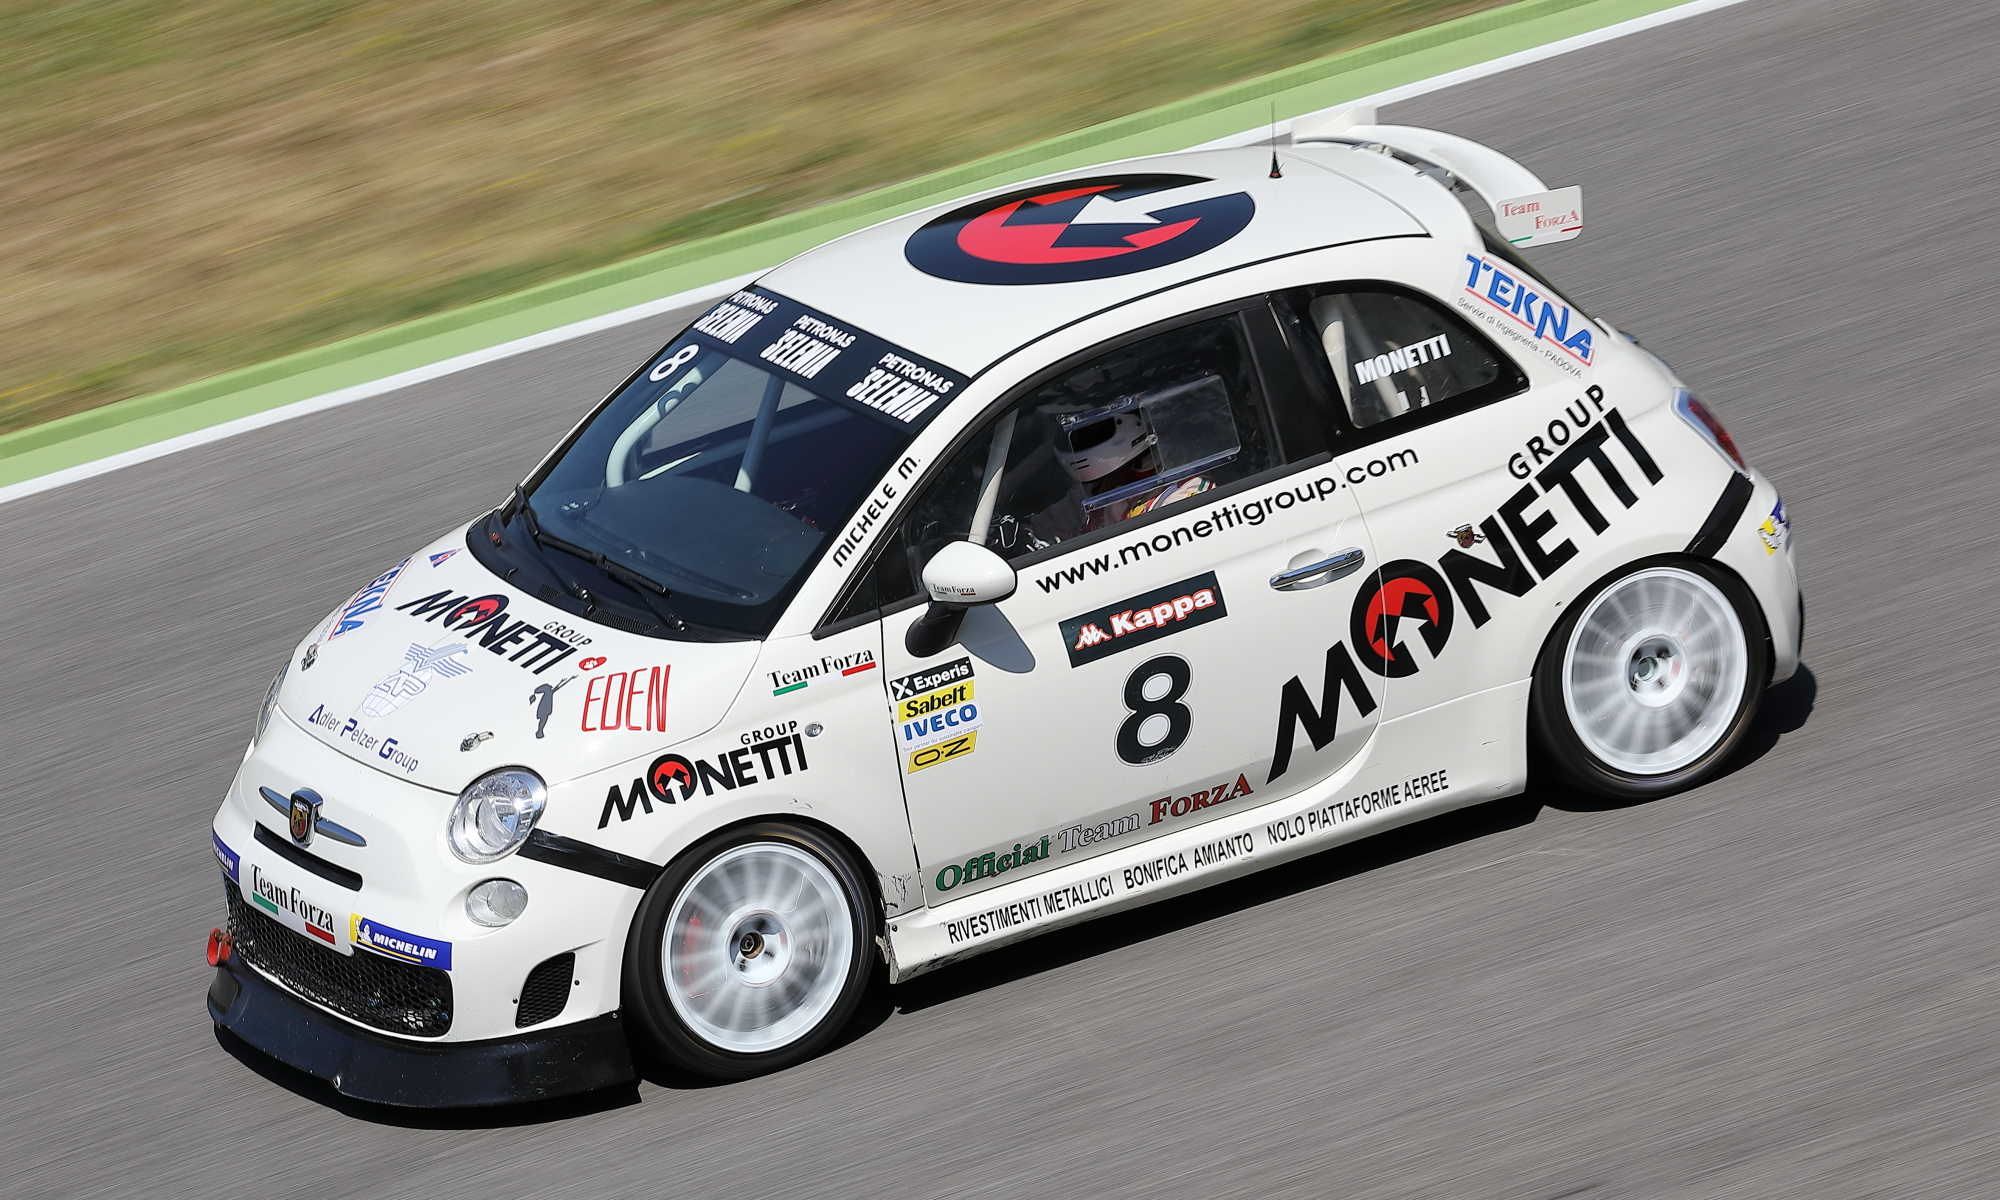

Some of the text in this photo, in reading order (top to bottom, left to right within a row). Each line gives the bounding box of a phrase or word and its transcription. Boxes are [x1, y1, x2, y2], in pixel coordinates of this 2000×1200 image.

[1501, 201, 1540, 218] Team
[728, 290, 780, 315] PETRONAS
[1466, 254, 1592, 359] TEKNA
[759, 328, 842, 380] SELENIA
[793, 314, 857, 348] PETRONAS
[1457, 297, 1486, 320] Servizi
[1485, 315, 1496, 326] di
[1495, 319, 1539, 352] Ingegneria
[1543, 350, 1583, 380] PADOVA
[649, 343, 700, 383] 8
[878, 352, 955, 394] PETRONAS
[1354, 333, 1453, 386] MONETTI
[845, 367, 940, 424] SELENIA
[1507, 383, 1606, 480] GROUP
[832, 456, 921, 568] MICHELE M.
[1036, 446, 1419, 594] www.monettigroup.com
[1109, 588, 1217, 638] Kappa
[1266, 407, 1665, 786] MONETTI
[394, 589, 578, 675] MONETTI
[543, 621, 593, 646] GROUP
[767, 649, 875, 688] Team Forza
[913, 663, 970, 691] Experis
[581, 664, 672, 733] EDEN
[903, 703, 978, 742] IVECO
[906, 685, 967, 718] Sabelt
[1113, 651, 1195, 768] 8
[308, 703, 419, 774] Adler Pelzer Group
[740, 720, 799, 745] GROUP
[902, 722, 984, 754] Your partner for sustainable transport
[597, 733, 809, 831] MONETTI
[935, 772, 1255, 892] Official Team FORZA
[946, 768, 1450, 945] RIVESTIMENTI METALLICI BONIFICA AMIANTO NOLO PIATTAFORME AEREE
[251, 863, 335, 933] Team Forza
[373, 931, 438, 960] MICHELIN
